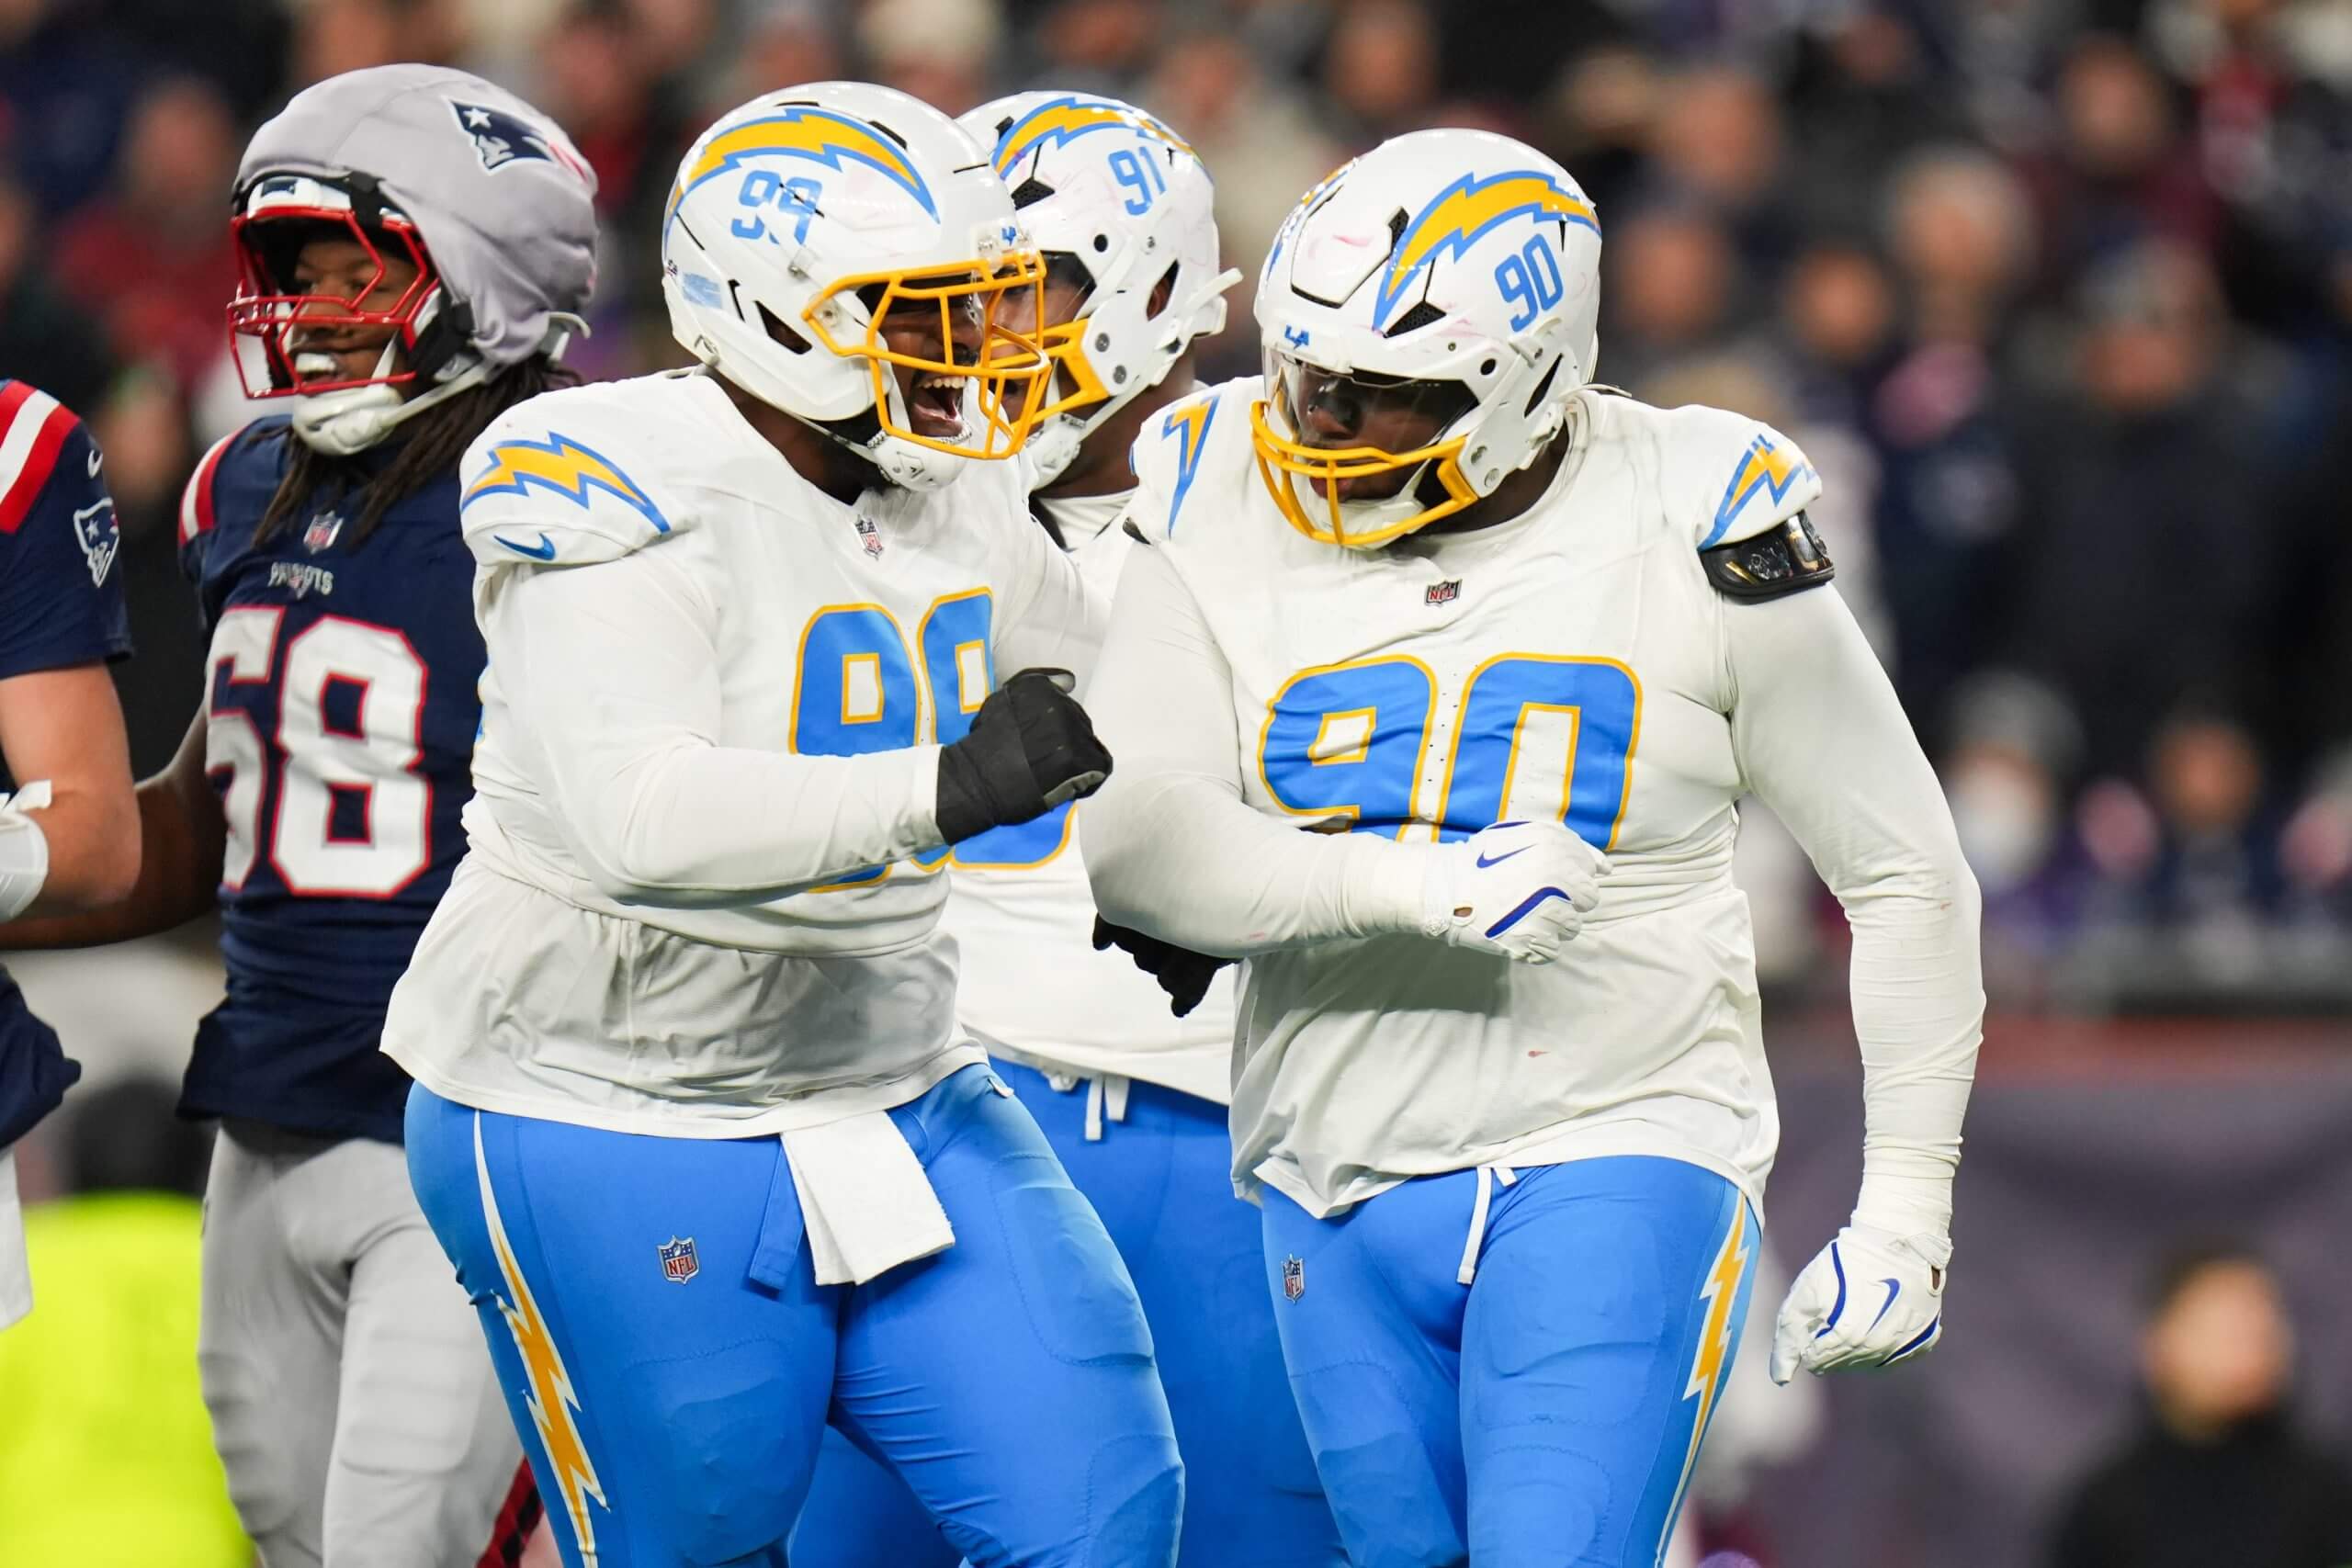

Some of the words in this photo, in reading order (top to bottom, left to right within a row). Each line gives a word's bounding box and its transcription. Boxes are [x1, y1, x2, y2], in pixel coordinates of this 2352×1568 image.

[730, 170, 823, 245] 99
[1108, 147, 1166, 216] 91
[1495, 233, 1563, 333] 90
[1430, 588, 1453, 600] NFL
[1257, 652, 1643, 852] 90
[667, 1255, 695, 1275] NFL
